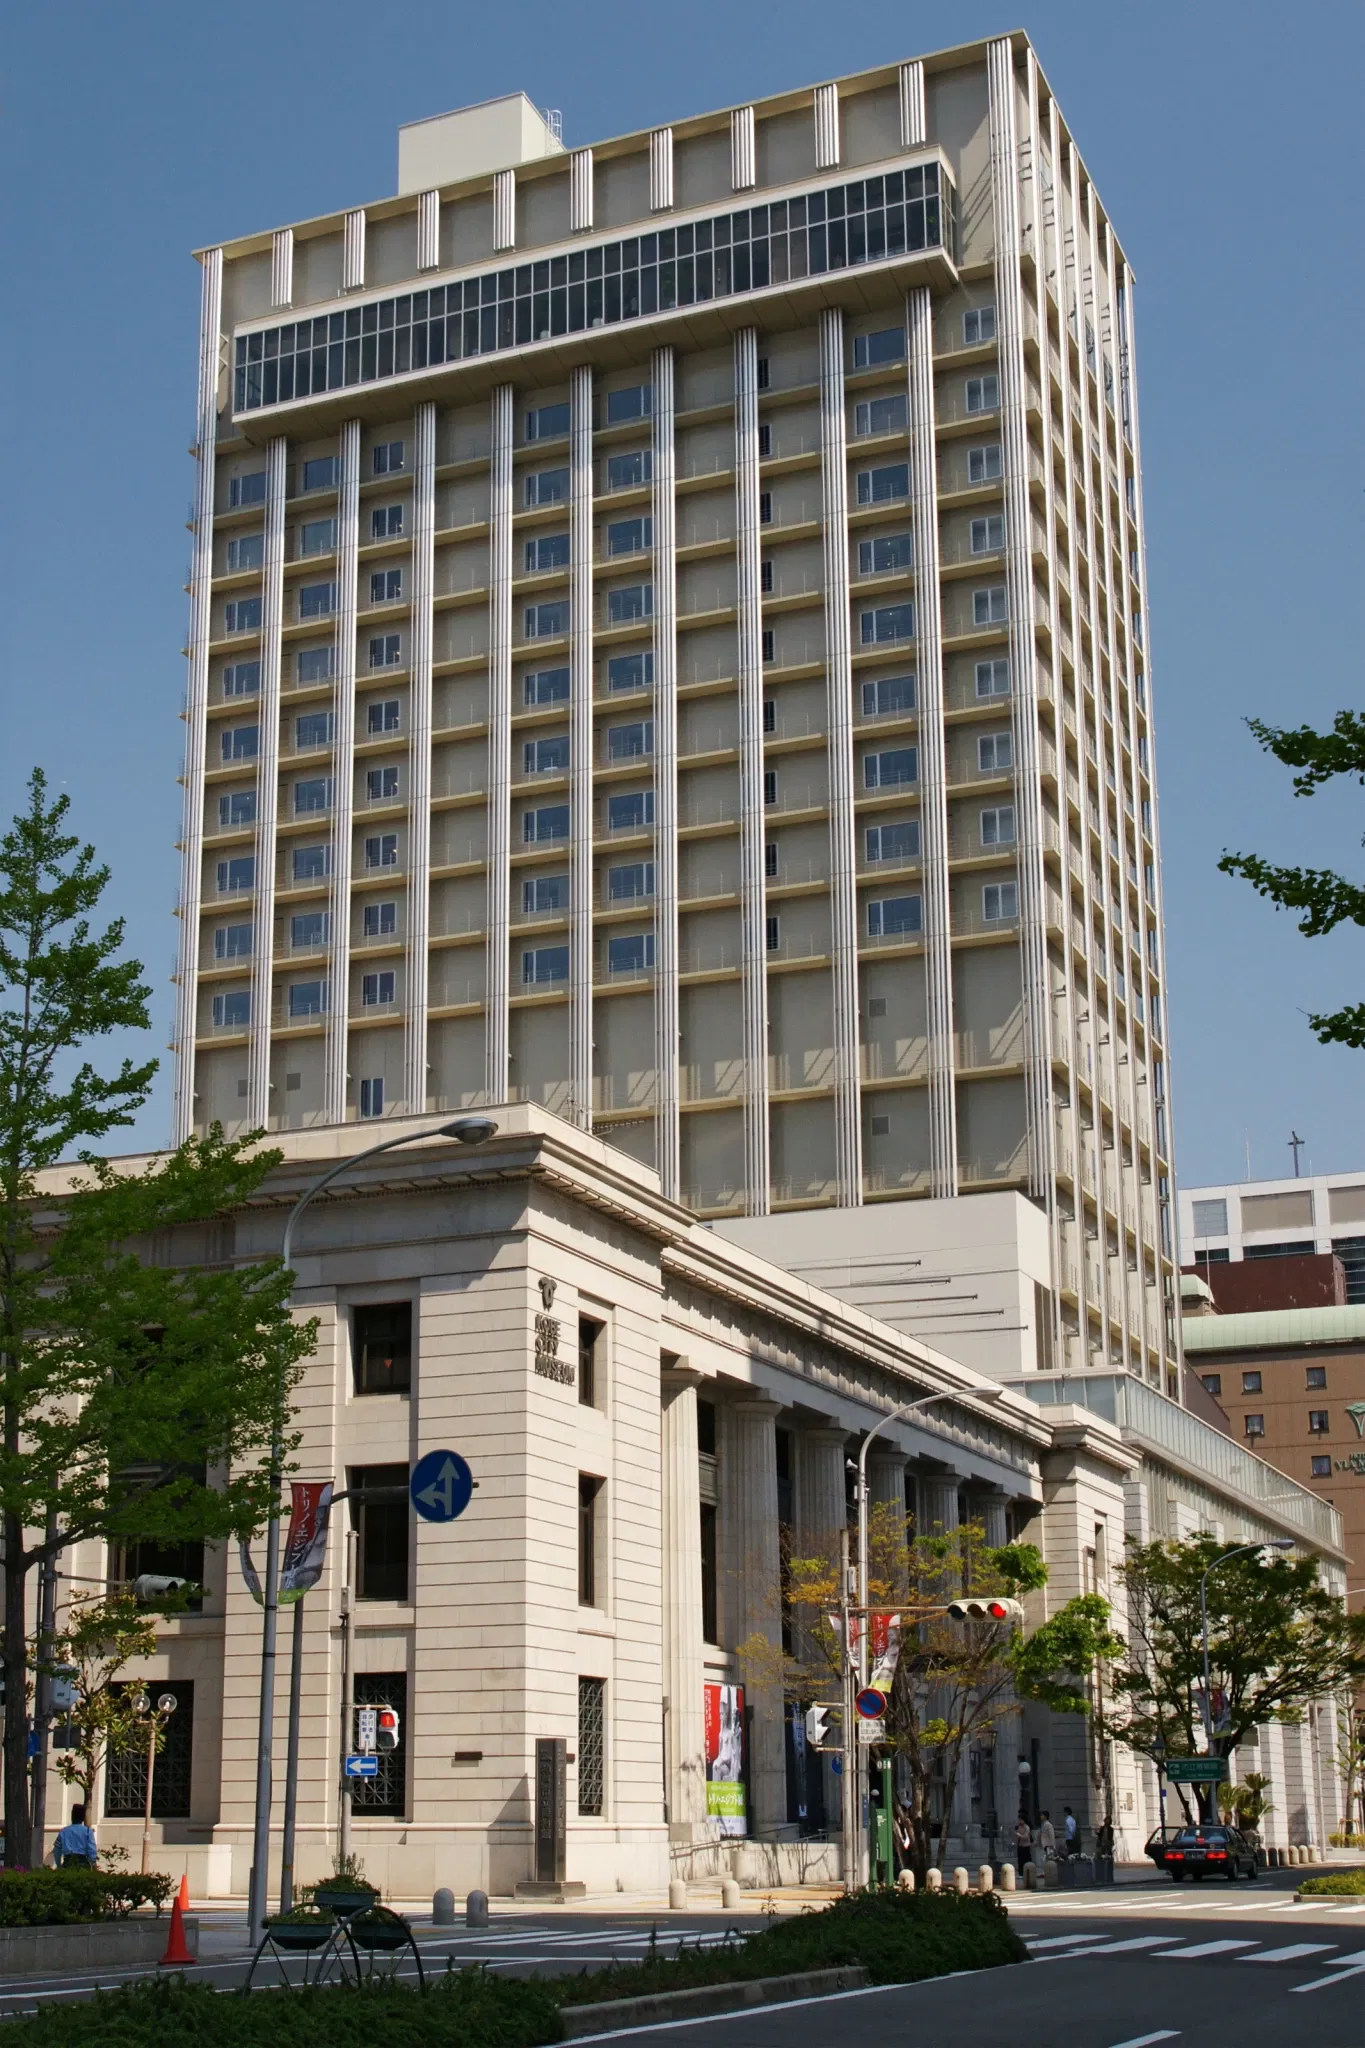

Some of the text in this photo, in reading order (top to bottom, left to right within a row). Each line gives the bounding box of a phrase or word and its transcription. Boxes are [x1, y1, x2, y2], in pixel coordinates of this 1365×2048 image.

[534, 1314, 561, 1337] KOBE
[534, 1336, 559, 1356] CITY
[534, 1354, 575, 1386] MUSEUM
